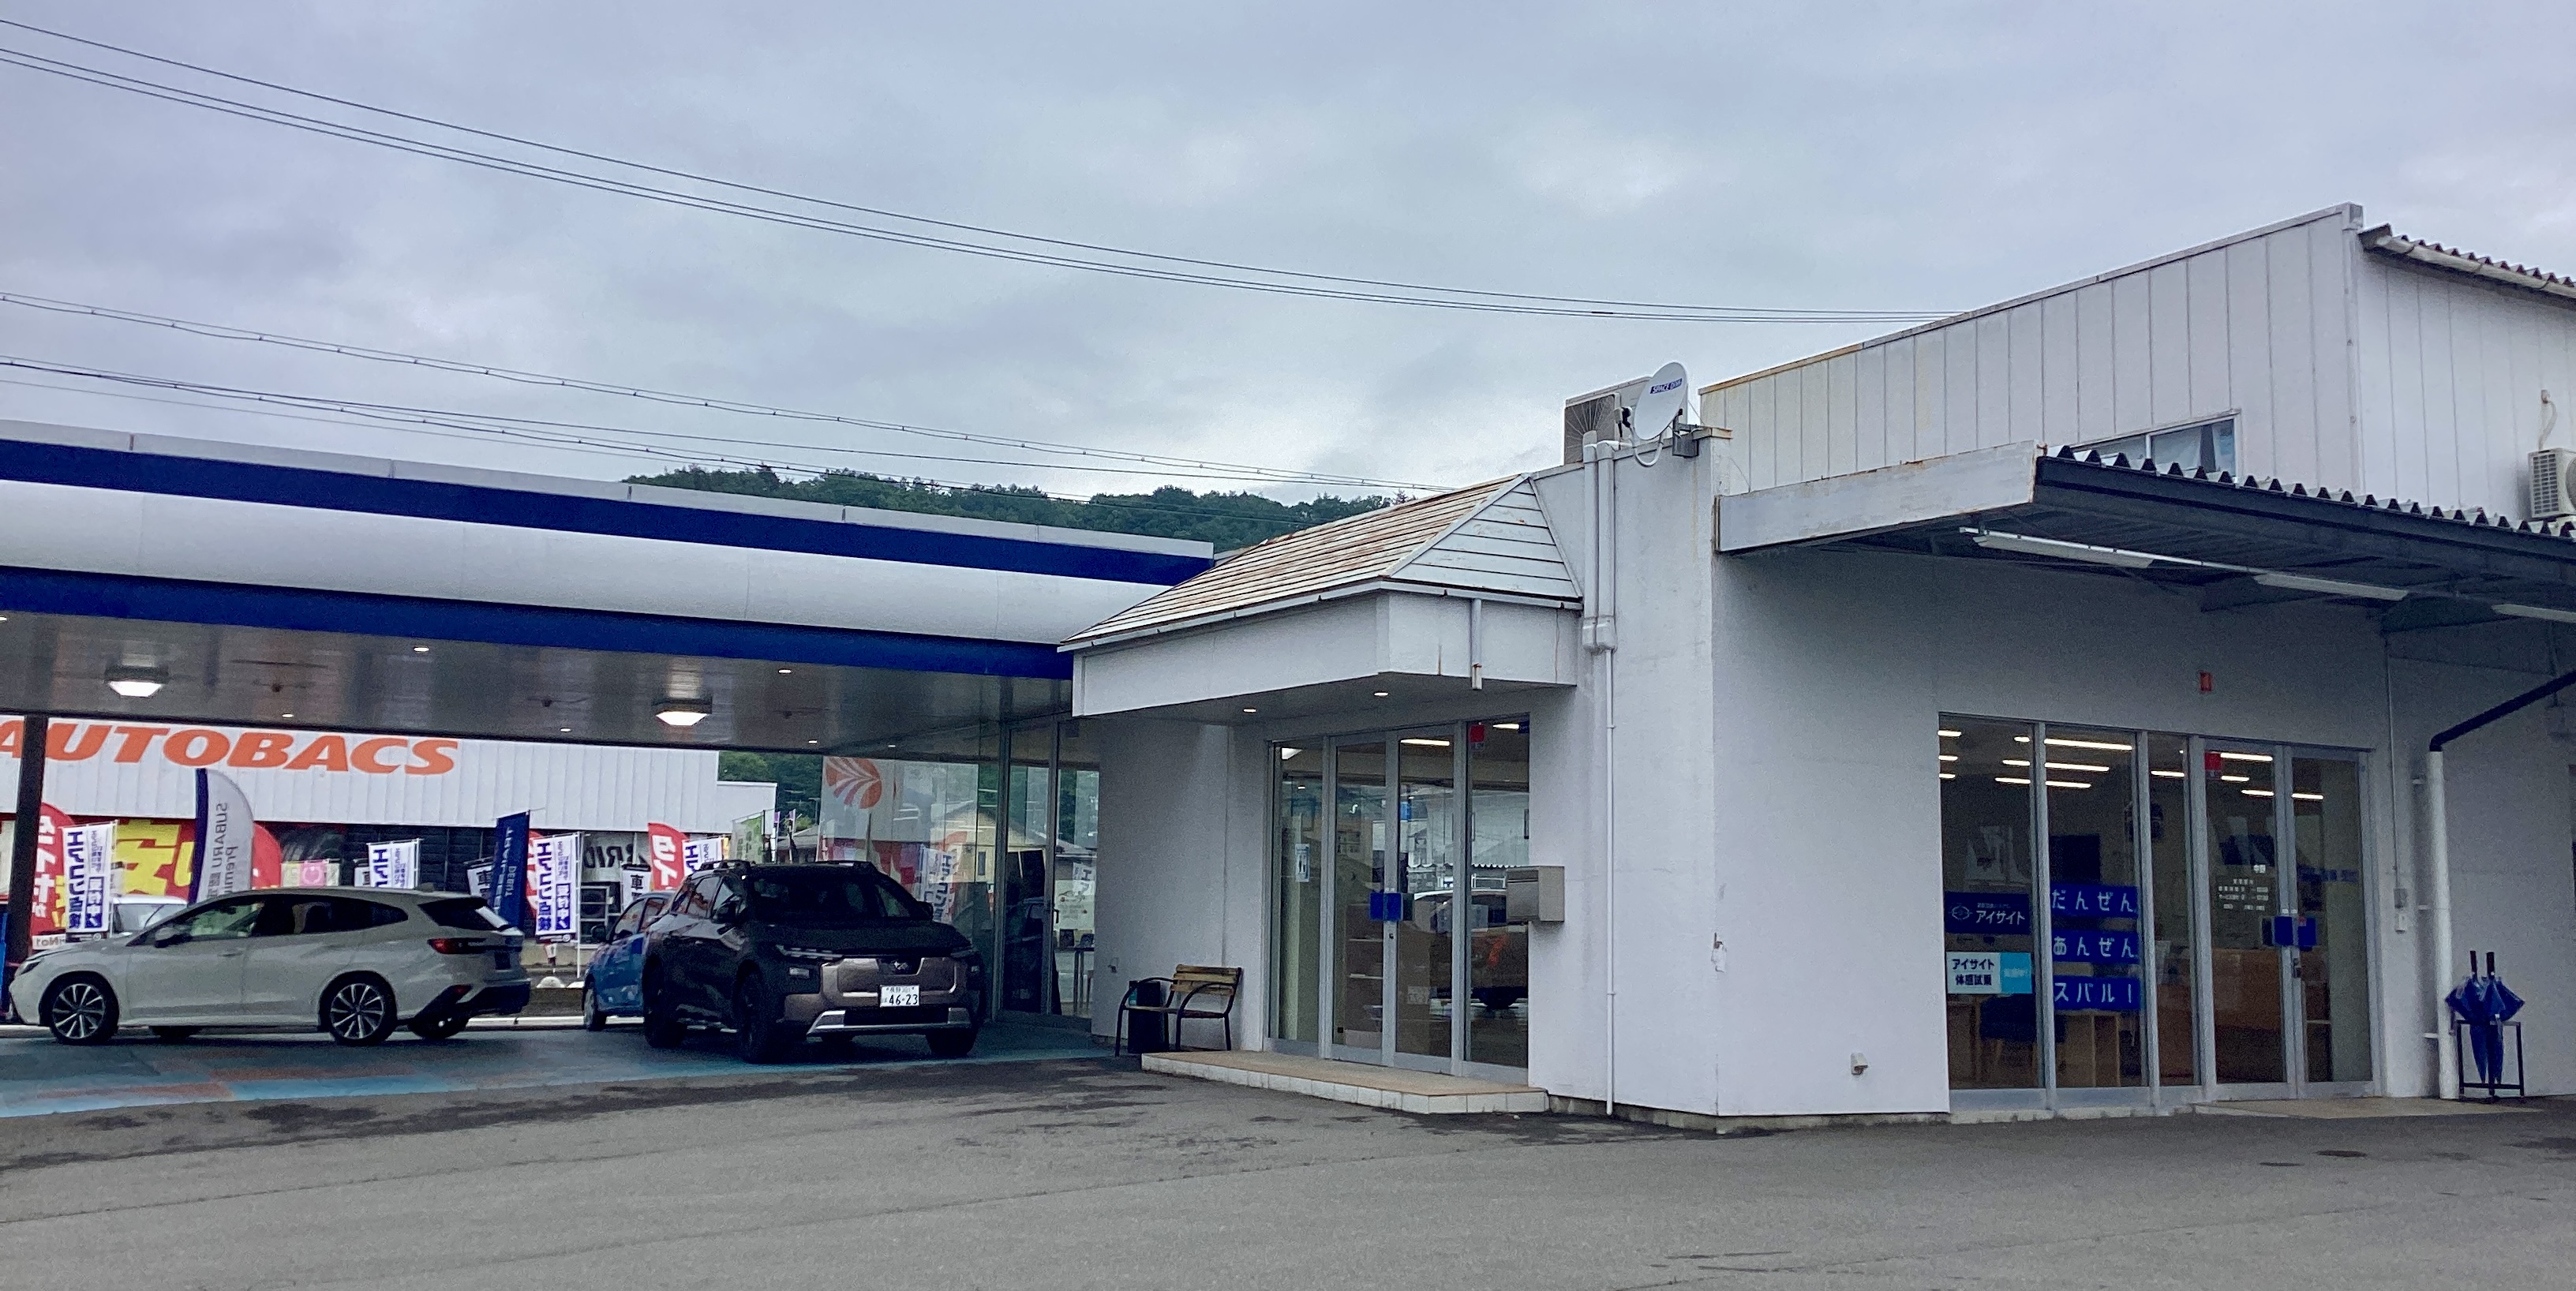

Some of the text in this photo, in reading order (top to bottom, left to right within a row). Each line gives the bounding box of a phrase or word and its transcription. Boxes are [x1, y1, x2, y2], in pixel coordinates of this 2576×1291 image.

[0, 720, 458, 775] AUTOBACS
[1975, 910, 2026, 926] アイサイト
[1952, 959, 1995, 971] アイサイト
